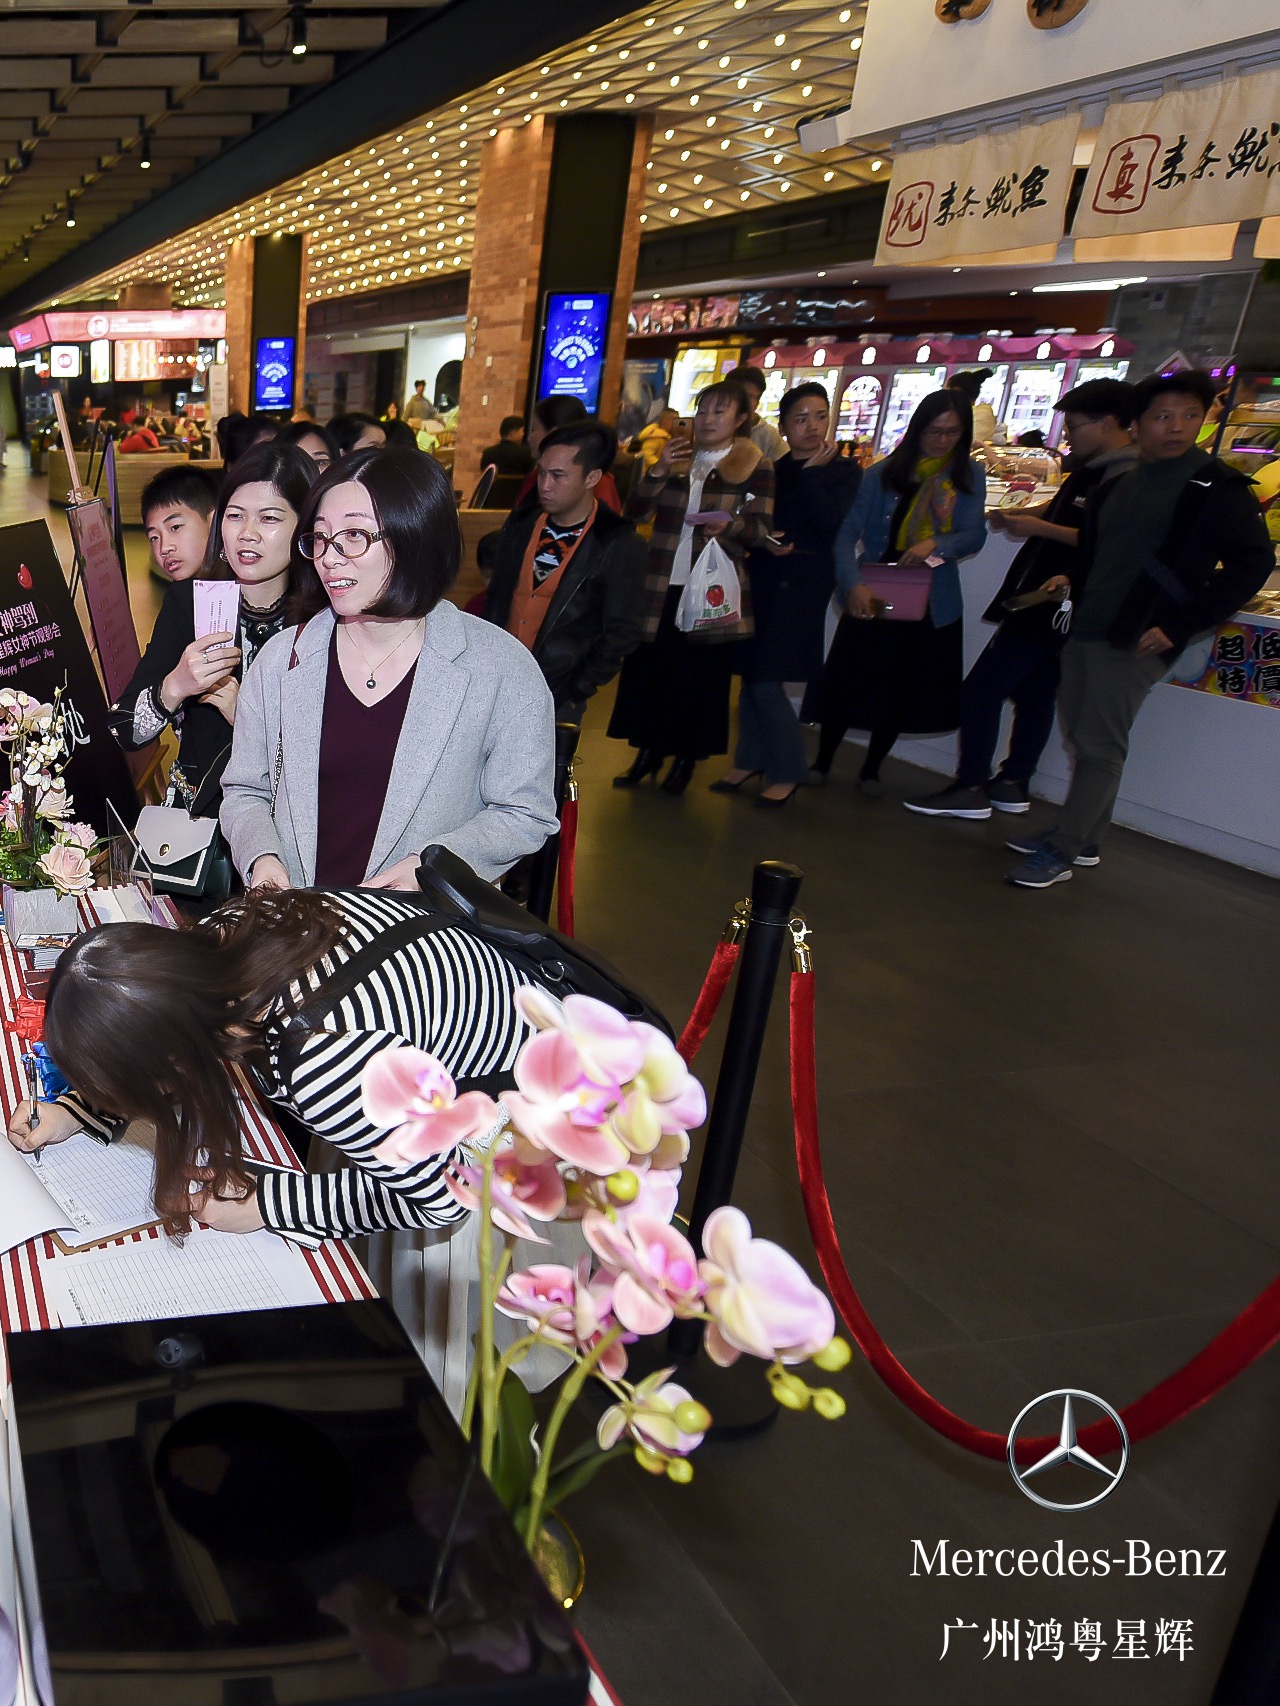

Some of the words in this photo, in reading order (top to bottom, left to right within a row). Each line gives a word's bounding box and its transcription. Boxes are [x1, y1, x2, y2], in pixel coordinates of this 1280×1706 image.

[43, 648, 55, 659] Day
[1216, 630, 1280, 663] 超低
[1216, 664, 1280, 694] 特價
